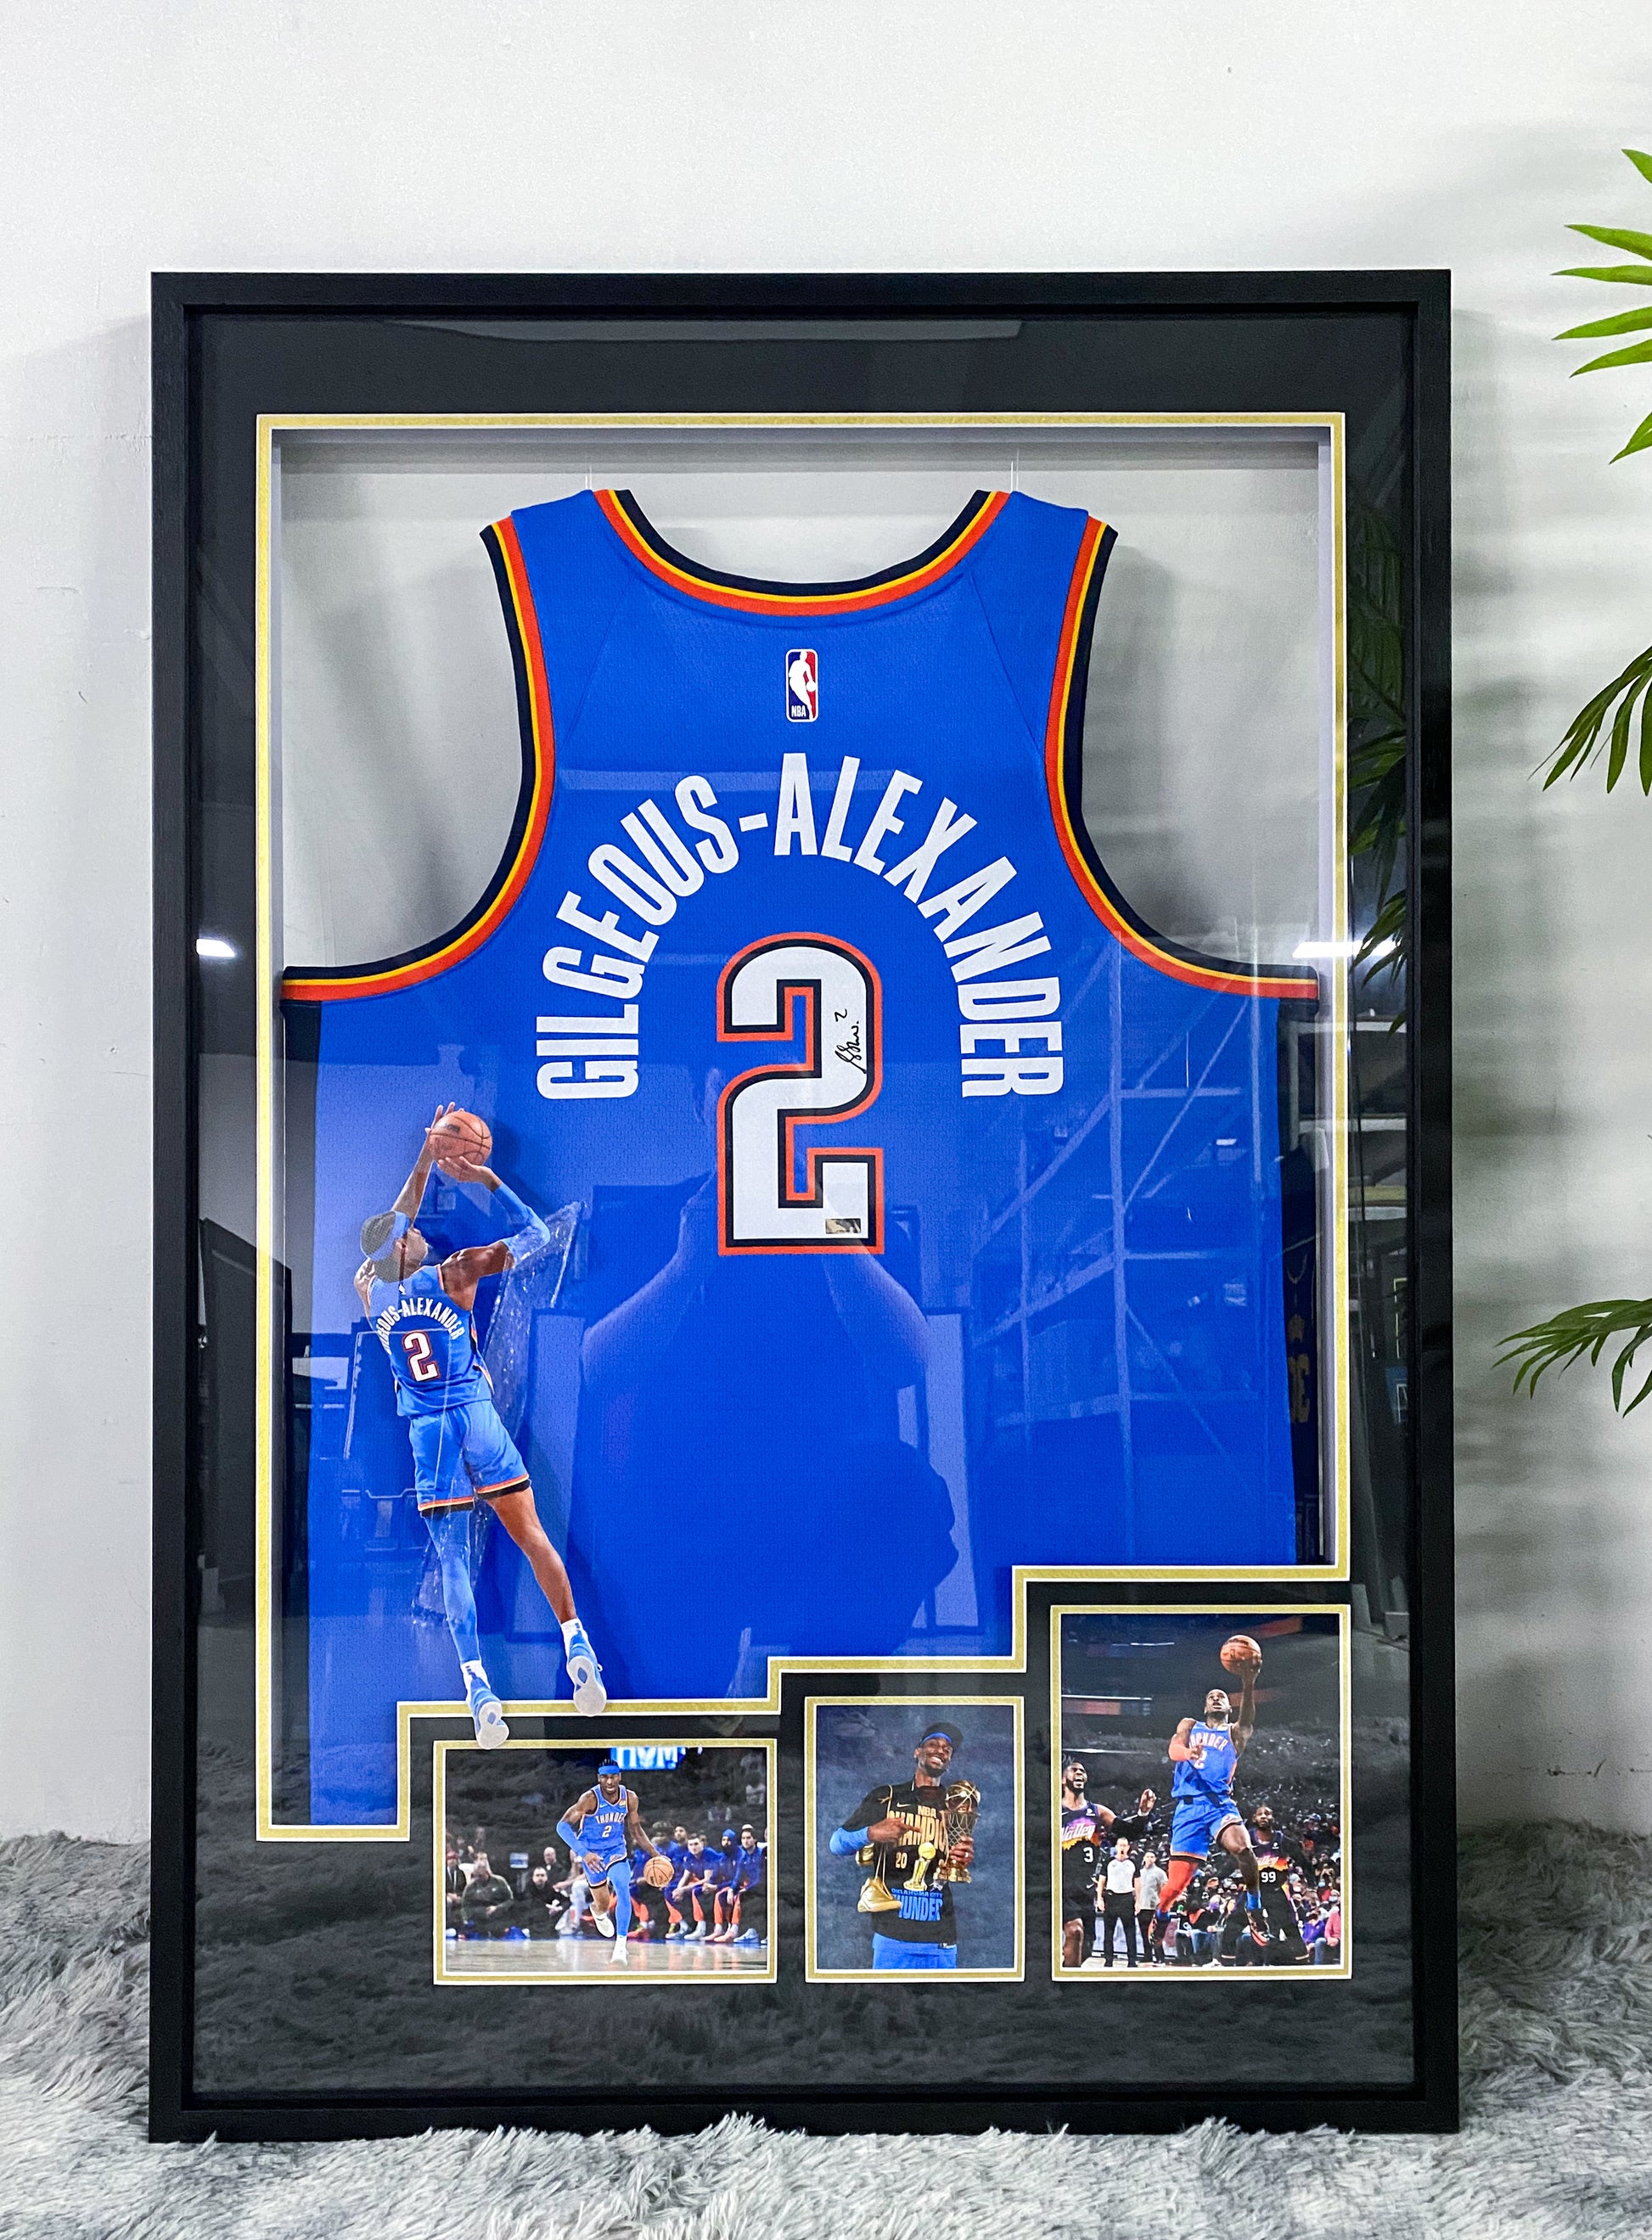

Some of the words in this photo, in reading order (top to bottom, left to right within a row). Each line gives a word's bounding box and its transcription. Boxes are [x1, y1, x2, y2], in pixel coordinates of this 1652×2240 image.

[791, 705, 807, 717] NBA
[536, 752, 1065, 1100] GILGEOUS-ALEXANDER
[716, 931, 884, 1255] 2
[402, 1329, 441, 1382] 2
[918, 1805, 936, 1819] NBA
[601, 1825, 612, 1838] 2
[895, 1852, 908, 1869] 20
[1082, 1846, 1094, 1863] 3
[1261, 1871, 1277, 1883] 99
[891, 1888, 930, 1898] OKLAHOMA
